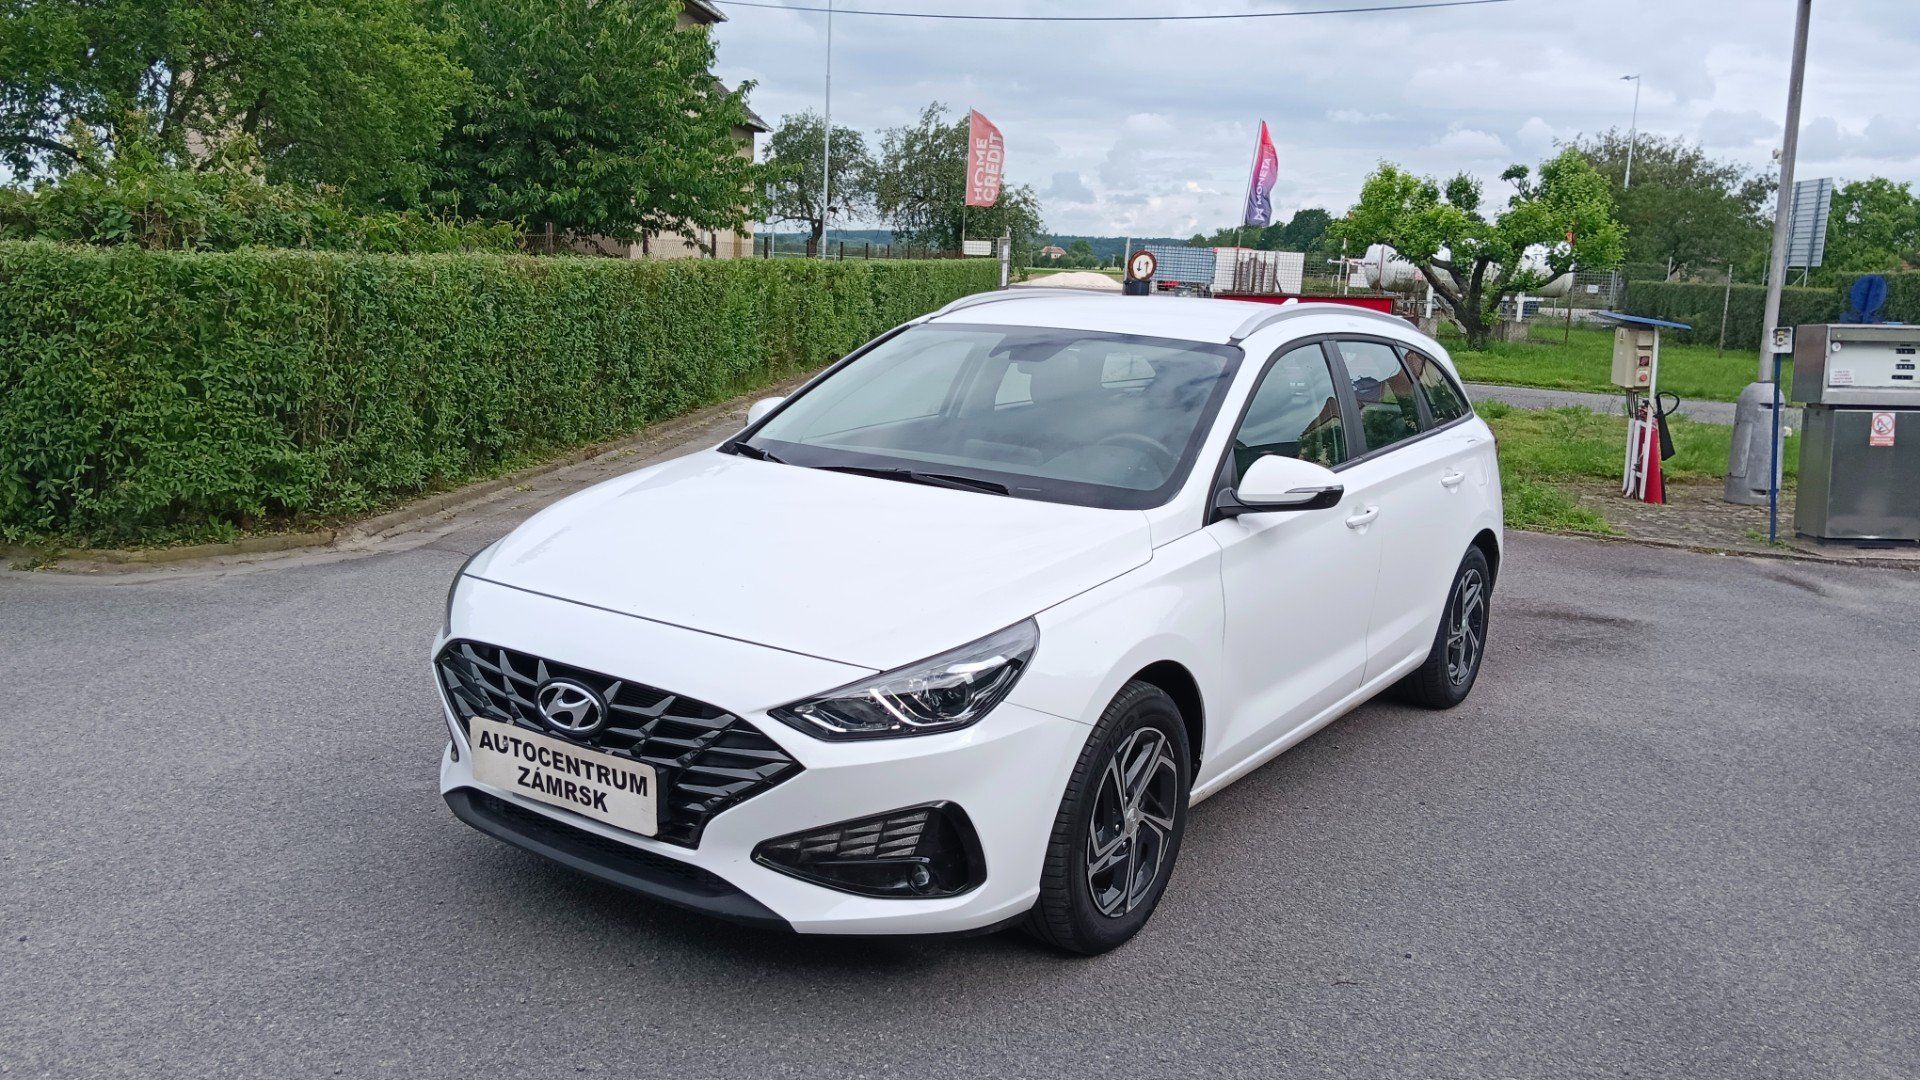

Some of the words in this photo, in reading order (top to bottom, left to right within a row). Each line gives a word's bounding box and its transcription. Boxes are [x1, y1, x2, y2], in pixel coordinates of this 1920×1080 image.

[974, 137, 988, 201] HOME
[983, 131, 1002, 202] CREDIT
[1256, 158, 1272, 205] MONETA
[479, 730, 648, 797] AUTOCENTRUM
[517, 765, 609, 813] ZÁMRSK
